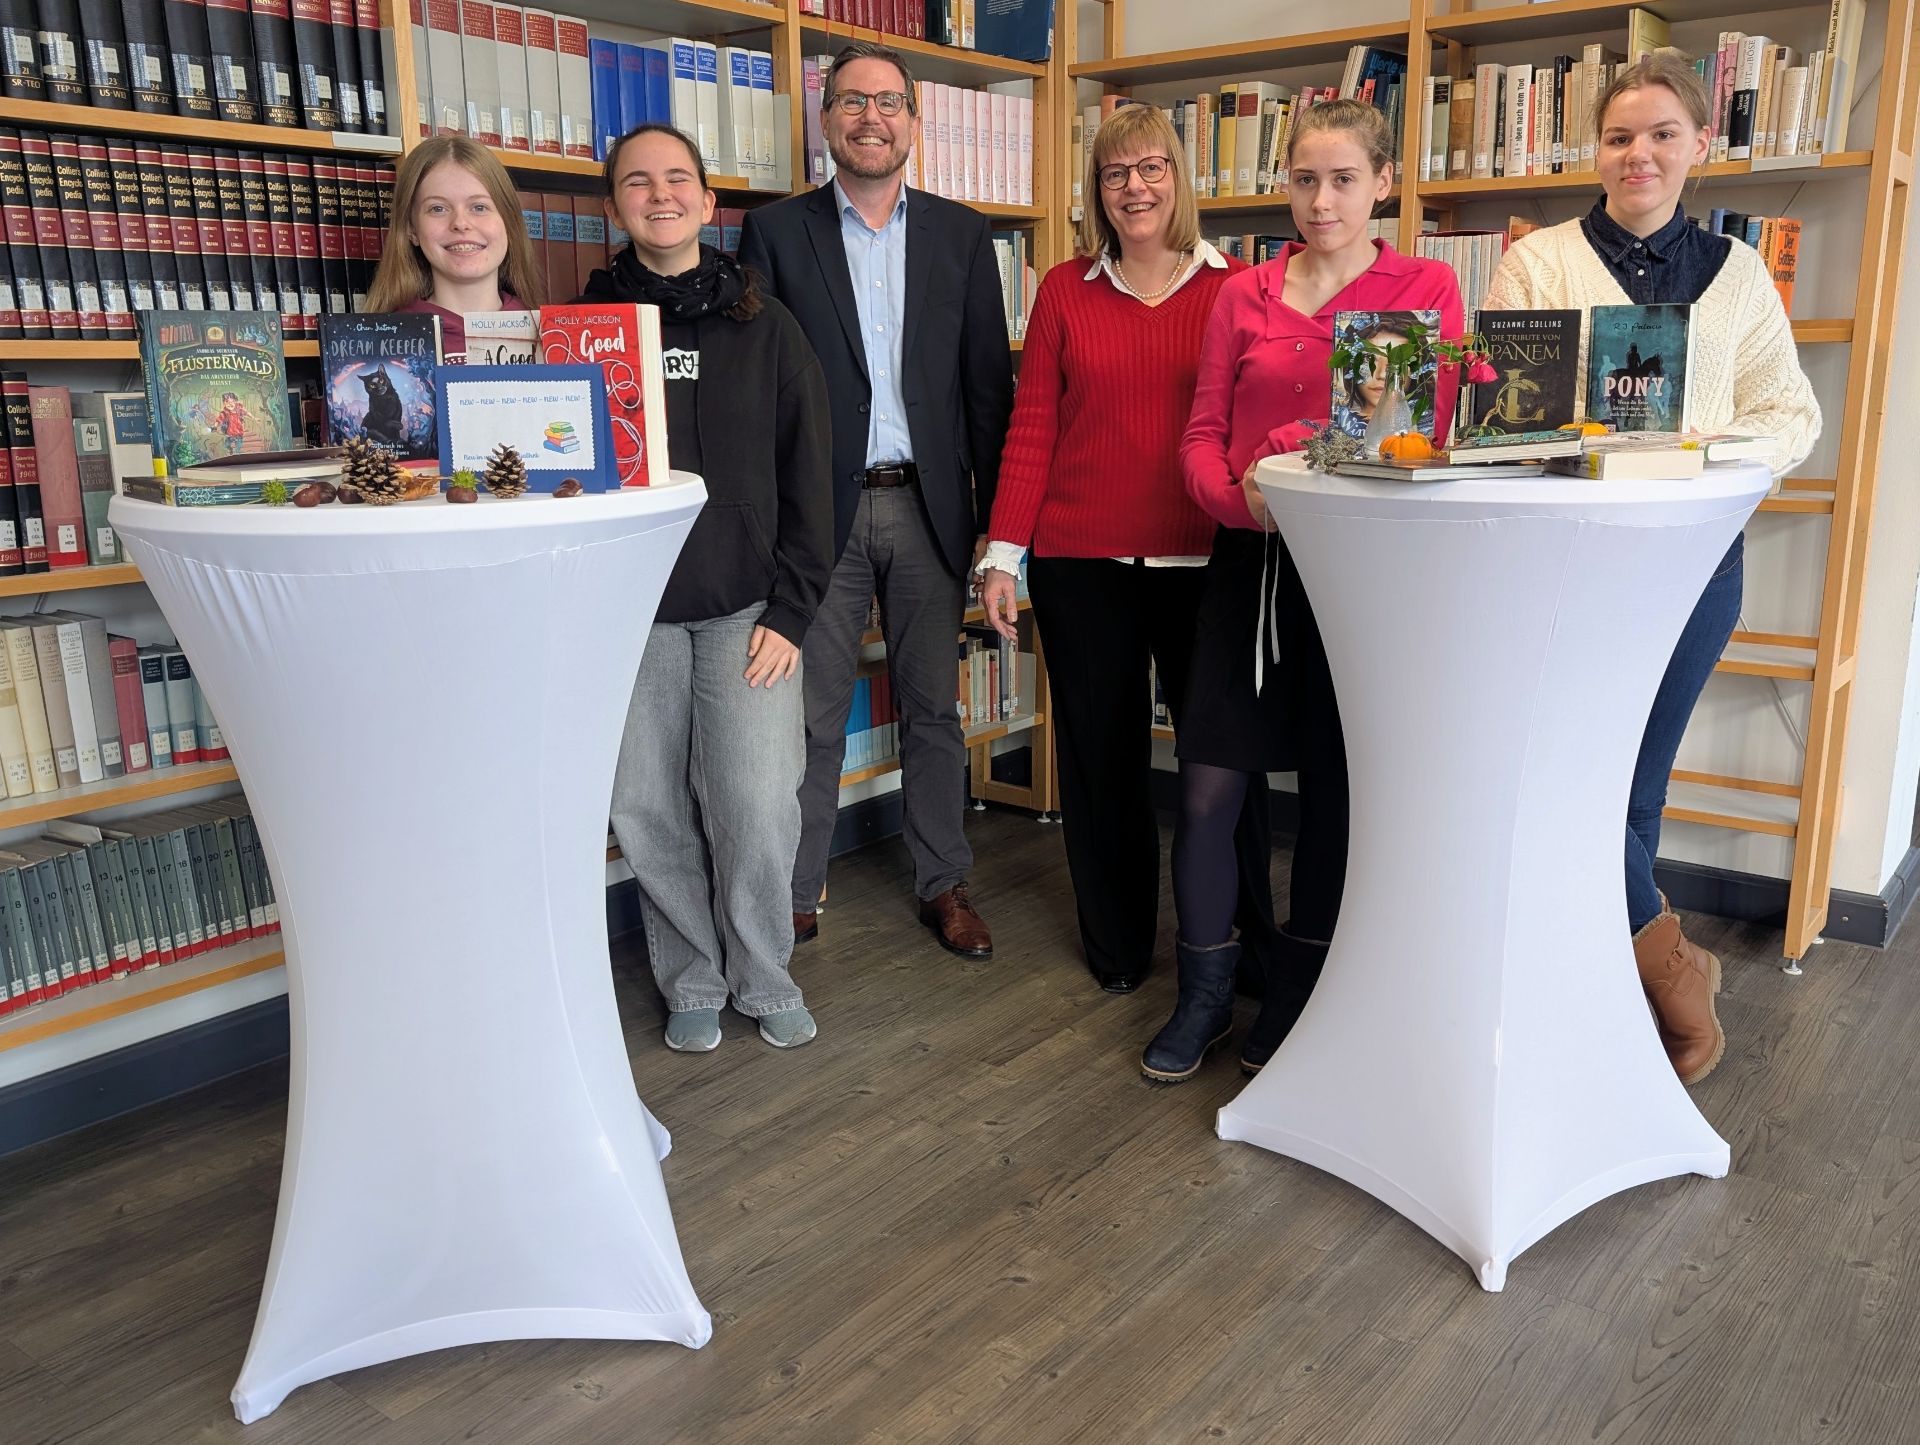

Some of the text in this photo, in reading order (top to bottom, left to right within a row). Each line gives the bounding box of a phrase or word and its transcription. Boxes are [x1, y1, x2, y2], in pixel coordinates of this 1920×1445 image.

[1828, 32, 1836, 54] Mekka
[1747, 40, 1756, 64] BÖSE
[22, 66, 30, 75] 21
[12, 78, 41, 89] SR-TEO
[108, 78, 118, 86] 23
[150, 83, 160, 92] 24
[196, 88, 204, 96] 25
[746, 151, 751, 160] 4
[0, 161, 22, 170] Collier's
[27, 163, 52, 174] Collier's
[57, 166, 81, 176] Collier's
[86, 168, 109, 178] Collier's
[114, 170, 137, 180] Collier's
[140, 172, 163, 182] Collier's
[168, 175, 190, 185] Collier's
[192, 178, 215, 186] Collier's
[219, 179, 240, 188] Collier's
[243, 181, 264, 190] Collier's
[6, 186, 24, 195] pedia
[36, 188, 53, 198] pedia
[64, 191, 82, 200] pedia
[93, 193, 110, 202] pedia
[121, 194, 138, 204] pedia
[148, 197, 164, 206] pedia
[174, 199, 190, 208] pedia
[199, 201, 215, 210] pedia
[225, 202, 240, 210] pedia
[250, 204, 264, 212] pedia
[1784, 233, 1794, 249] Der
[472, 319, 531, 329] HOLLY JACKSON
[554, 315, 621, 325] HOLLY JACKSON
[332, 338, 426, 358] DREAM KEEPER
[580, 326, 626, 363] Good
[484, 344, 537, 365] A Good
[1491, 341, 1560, 366] PANEM
[168, 354, 272, 376] FLÜSTERWALD
[1604, 376, 1665, 397] PONY
[7, 405, 30, 415] Collier's
[14, 417, 28, 426] Year
[16, 428, 30, 436] Book
[242, 845, 252, 854] 22
[208, 853, 219, 862] 20
[64, 887, 73, 895] 11
